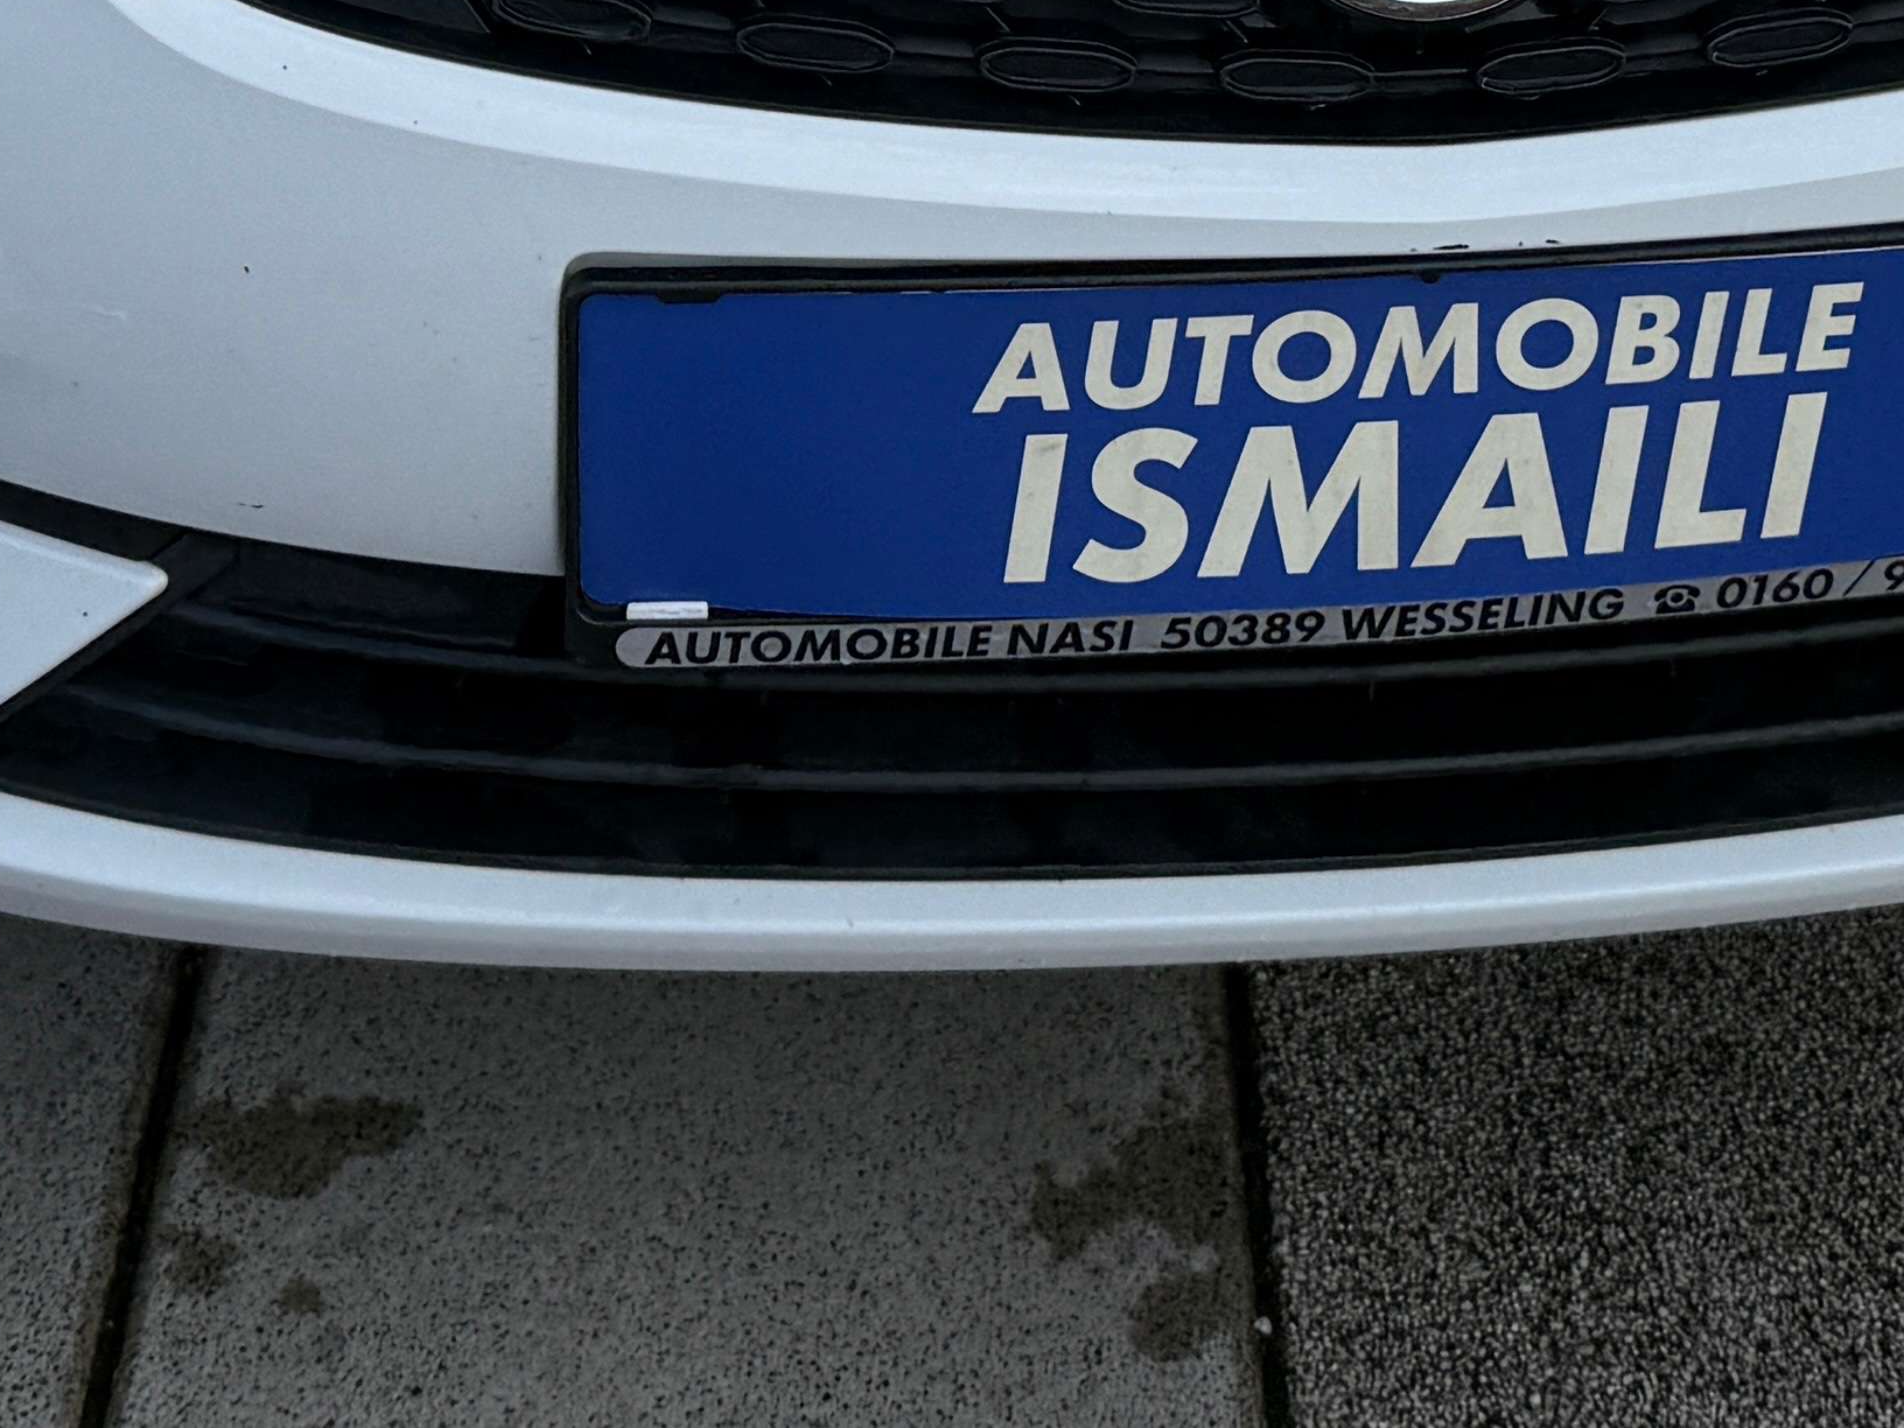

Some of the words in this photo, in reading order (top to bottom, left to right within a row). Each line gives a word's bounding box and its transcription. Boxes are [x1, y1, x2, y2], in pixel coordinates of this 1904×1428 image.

[972, 281, 1864, 414] AUTOMOBILE
[1003, 391, 1828, 584] ISMAILI
[644, 624, 993, 665] AUTOMOBILE
[1007, 619, 1135, 657] NASI
[1160, 610, 1326, 650] 50389
[1342, 588, 1625, 642] WESSELING
[1716, 566, 1834, 610] 0160
[1844, 560, 1875, 597] /
